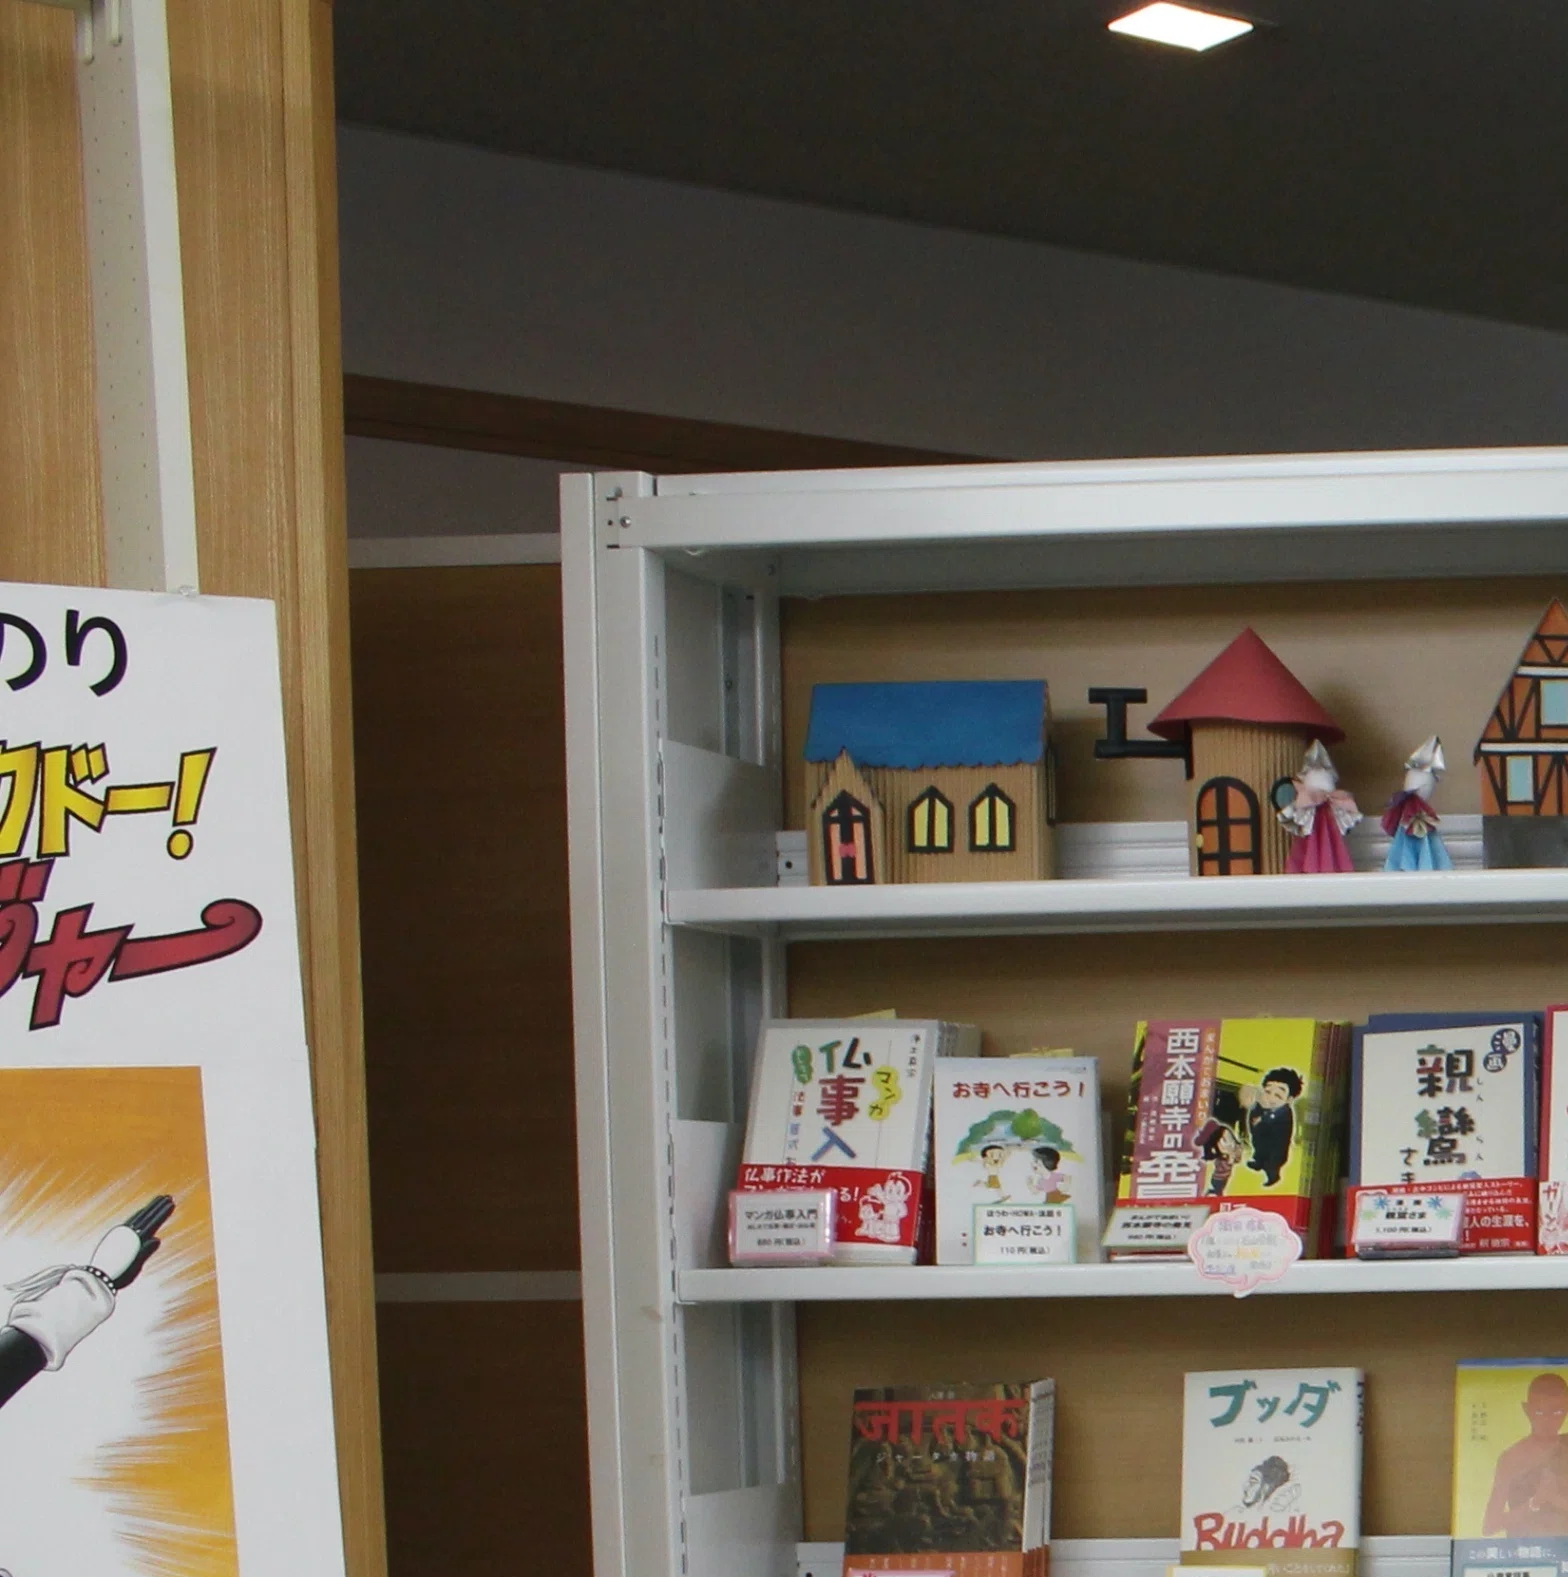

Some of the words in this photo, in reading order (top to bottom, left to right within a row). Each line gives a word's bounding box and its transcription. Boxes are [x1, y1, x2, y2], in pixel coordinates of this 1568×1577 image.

[952, 1080, 1086, 1098] お寺へ行こう！
[1413, 1044, 1476, 1166] 親鸞
[983, 1224, 1062, 1237] お寺へ行こう！
[1208, 1379, 1342, 1429] ブッダ
[1192, 1512, 1346, 1551] Buddha
